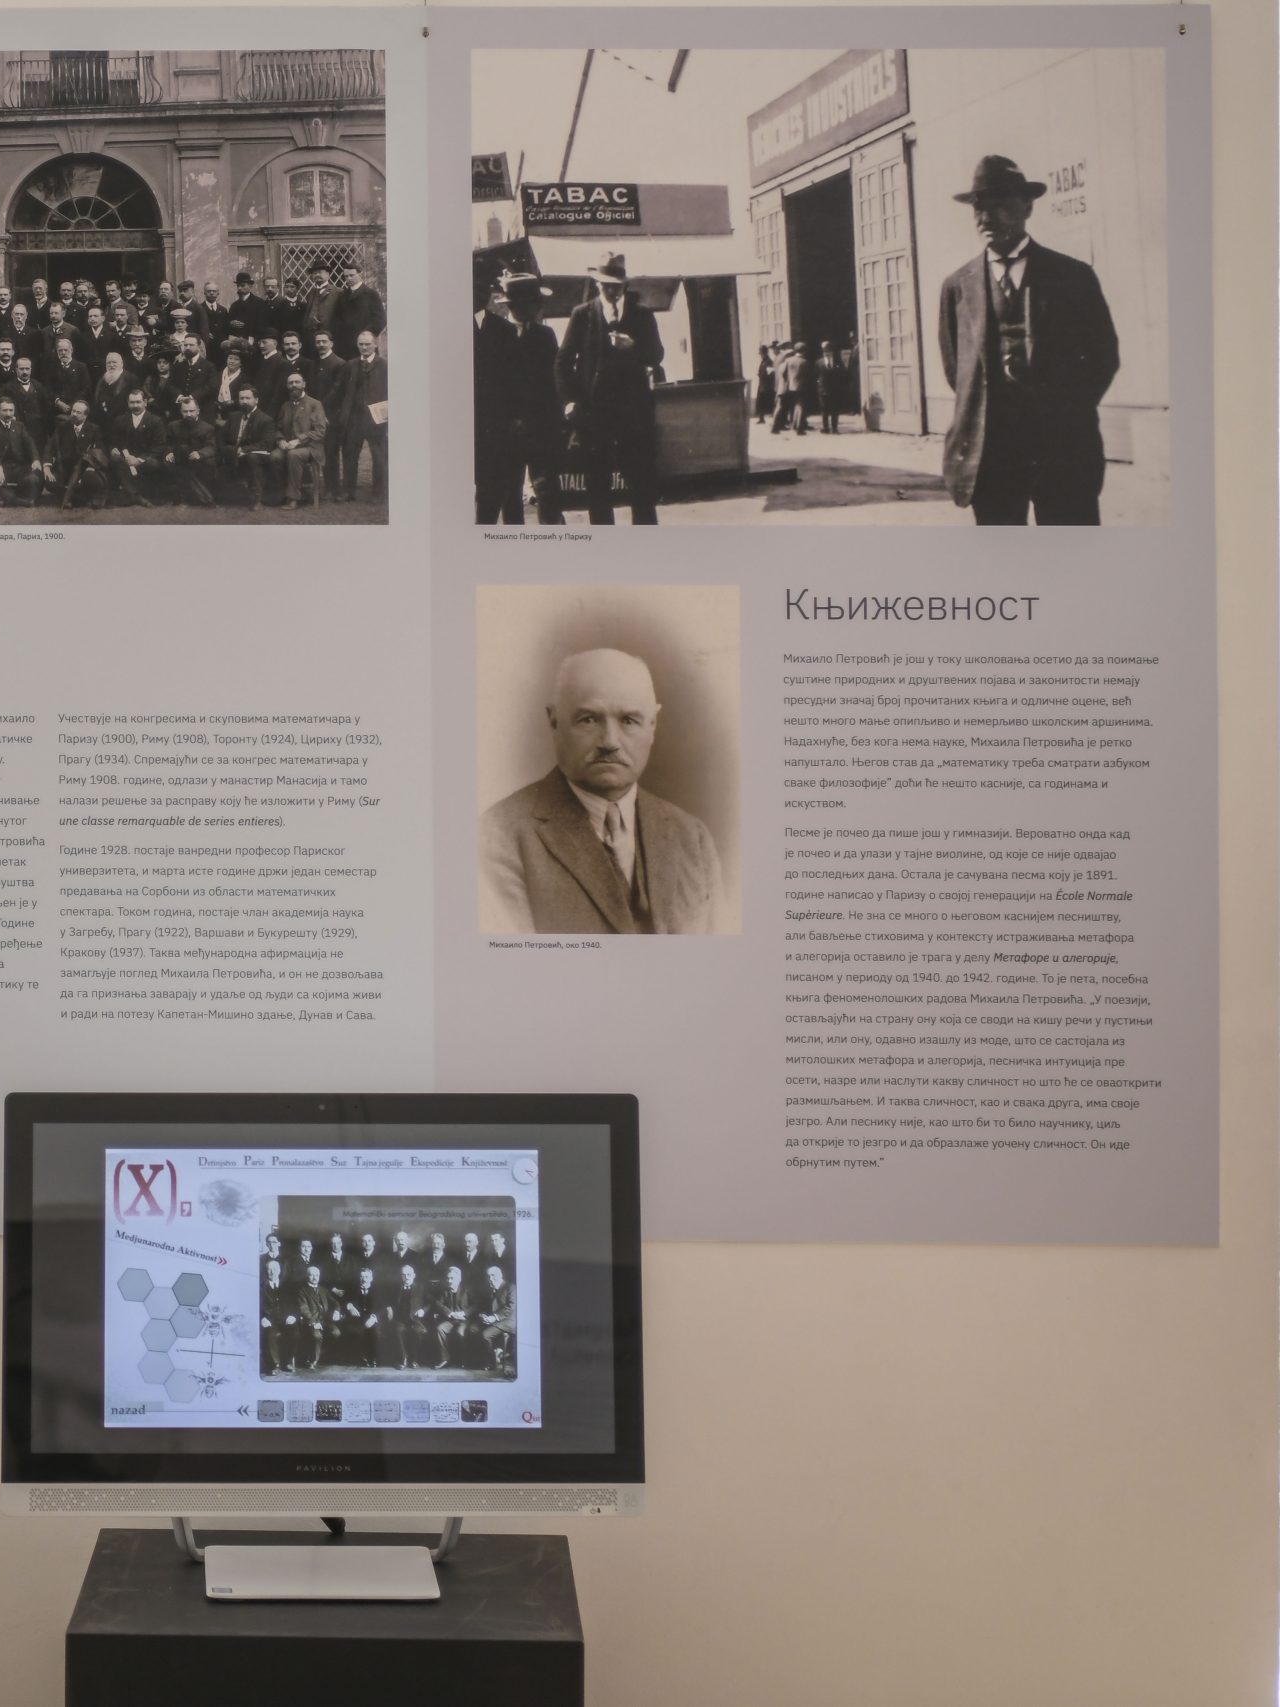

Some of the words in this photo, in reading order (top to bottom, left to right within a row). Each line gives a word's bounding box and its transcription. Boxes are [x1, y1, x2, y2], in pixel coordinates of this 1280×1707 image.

[528, 187, 628, 204] TABAC
[785, 588, 1040, 622] Књижевност
[783, 676, 831, 687] суштине
[835, 676, 895, 687] природних
[899, 676, 905, 685] и
[907, 676, 976, 687] друштвених
[980, 674, 1016, 687] појава
[1019, 677, 1025, 685] и
[1029, 676, 1100, 686] законитости
[1103, 674, 1140, 688] немају
[784, 717, 819, 726] нешто
[823, 717, 856, 726] много
[859, 717, 890, 726] мање
[893, 717, 950, 726] опипљиво
[954, 718, 960, 726] и
[964, 718, 1028, 729] немерљиво
[1032, 718, 1088, 727] школским
[1092, 718, 1153, 729] аршинима.
[59, 733, 98, 747] Паризу
[102, 733, 138, 745] (1900),
[142, 733, 169, 746] Риму
[173, 733, 209, 746] (1908),
[213, 733, 257, 747] Торонту
[261, 733, 297, 746] (1924),
[301, 734, 342, 747] Цириху
[346, 733, 382, 746] (1932),
[59, 817, 78, 826] une
[82, 815, 114, 826] classe
[118, 815, 185, 829] remarquable
[188, 815, 201, 826] de
[204, 815, 235, 827] series
[238, 815, 285, 828] entieres).
[60, 887, 122, 898] предавања
[126, 888, 139, 896] на
[142, 885, 189, 899] Сорбони
[193, 888, 205, 897] из
[209, 885, 253, 897] области
[257, 888, 335, 897] математичких
[58, 947, 106, 960] Кракову
[108, 946, 146, 960] (1937).
[148, 947, 181, 958] Таква
[184, 947, 258, 961] међународна
[260, 948, 328, 961] афирмација
[330, 950, 344, 959] не
[786, 953, 792, 961] и
[795, 951, 850, 964] алегорија
[854, 953, 905, 962] оставило
[909, 951, 918, 964] је
[921, 954, 952, 964] трага
[955, 954, 961, 965] у
[964, 954, 990, 965] делу
[994, 952, 1049, 965] Метафоре
[1052, 954, 1059, 963] и
[1062, 952, 1118, 966] алегорије,
[27, 981, 39, 990] те
[786, 994, 820, 1003] књига
[824, 992, 923, 1005] феноменолошких
[927, 995, 967, 1006] радова
[971, 993, 1020, 1004] Михаила
[1023, 993, 1086, 1007] Петровића.
[1090, 994, 1101, 1006] „У
[1105, 994, 1150, 1008] поезији,
[61, 1010, 67, 1019] и
[71, 1010, 97, 1021] ради
[102, 1010, 114, 1019] на
[118, 1010, 154, 1022] потезу
[158, 1009, 254, 1020] Капетан-Мишино
[257, 1011, 295, 1021] здање,
[298, 1009, 332, 1022] Дунав
[337, 1012, 342, 1020] и
[346, 1010, 375, 1021] Сава.
[786, 1056, 855, 1065] митолошких
[859, 1055, 914, 1068] метафора
[918, 1057, 924, 1065] и
[928, 1055, 985, 1068] алегорија,
[989, 1057, 1042, 1066] песничка
[1045, 1056, 1101, 1069] интуиција
[1105, 1058, 1125, 1069] пре
[785, 1156, 841, 1170] обрнутим
[844, 1157, 887, 1170] путем.”
[115, 1229, 175, 1252] Medjunarodna
[177, 1246, 218, 1263] Aktivnost
[110, 1404, 146, 1416] nazad
